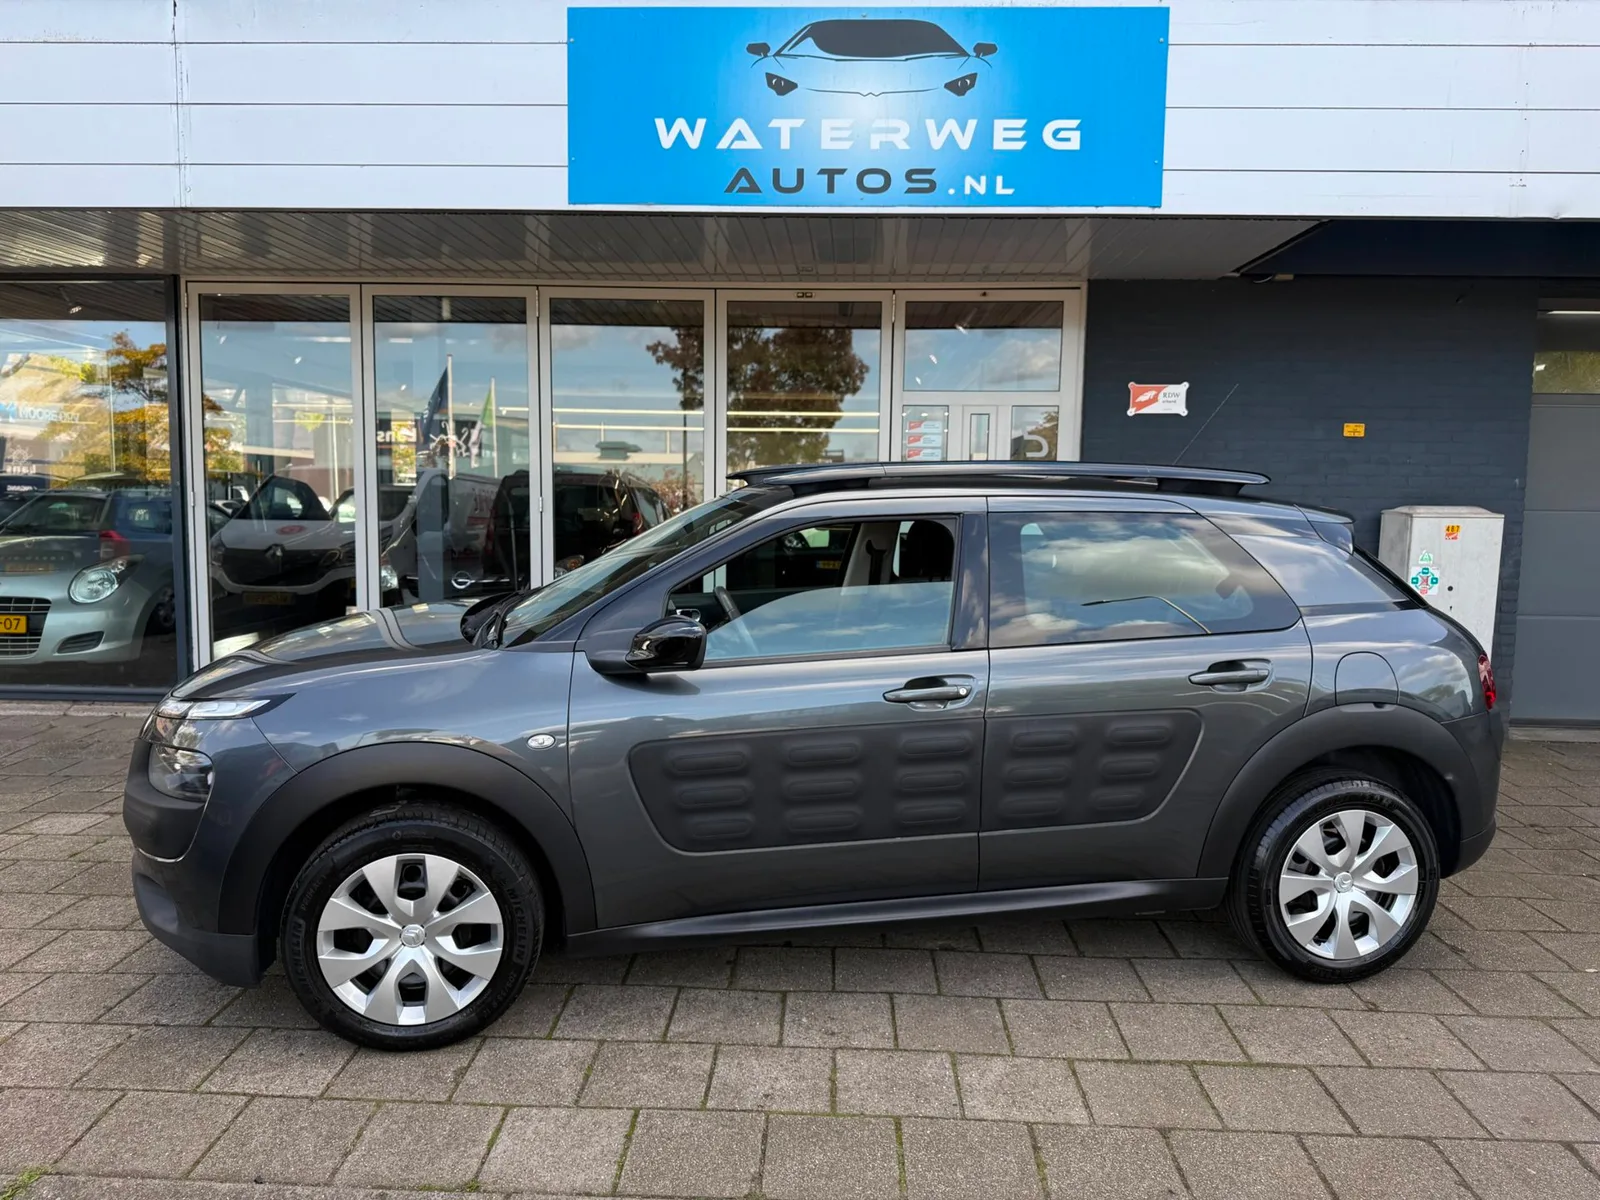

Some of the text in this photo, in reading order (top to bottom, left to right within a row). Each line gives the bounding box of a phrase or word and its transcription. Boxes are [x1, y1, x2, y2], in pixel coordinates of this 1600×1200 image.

[654, 118, 1081, 150] WATERWEG
[724, 168, 1015, 195] AUTOS.NL
[1162, 391, 1181, 399] RDW
[507, 888, 528, 961] MICHELIN
